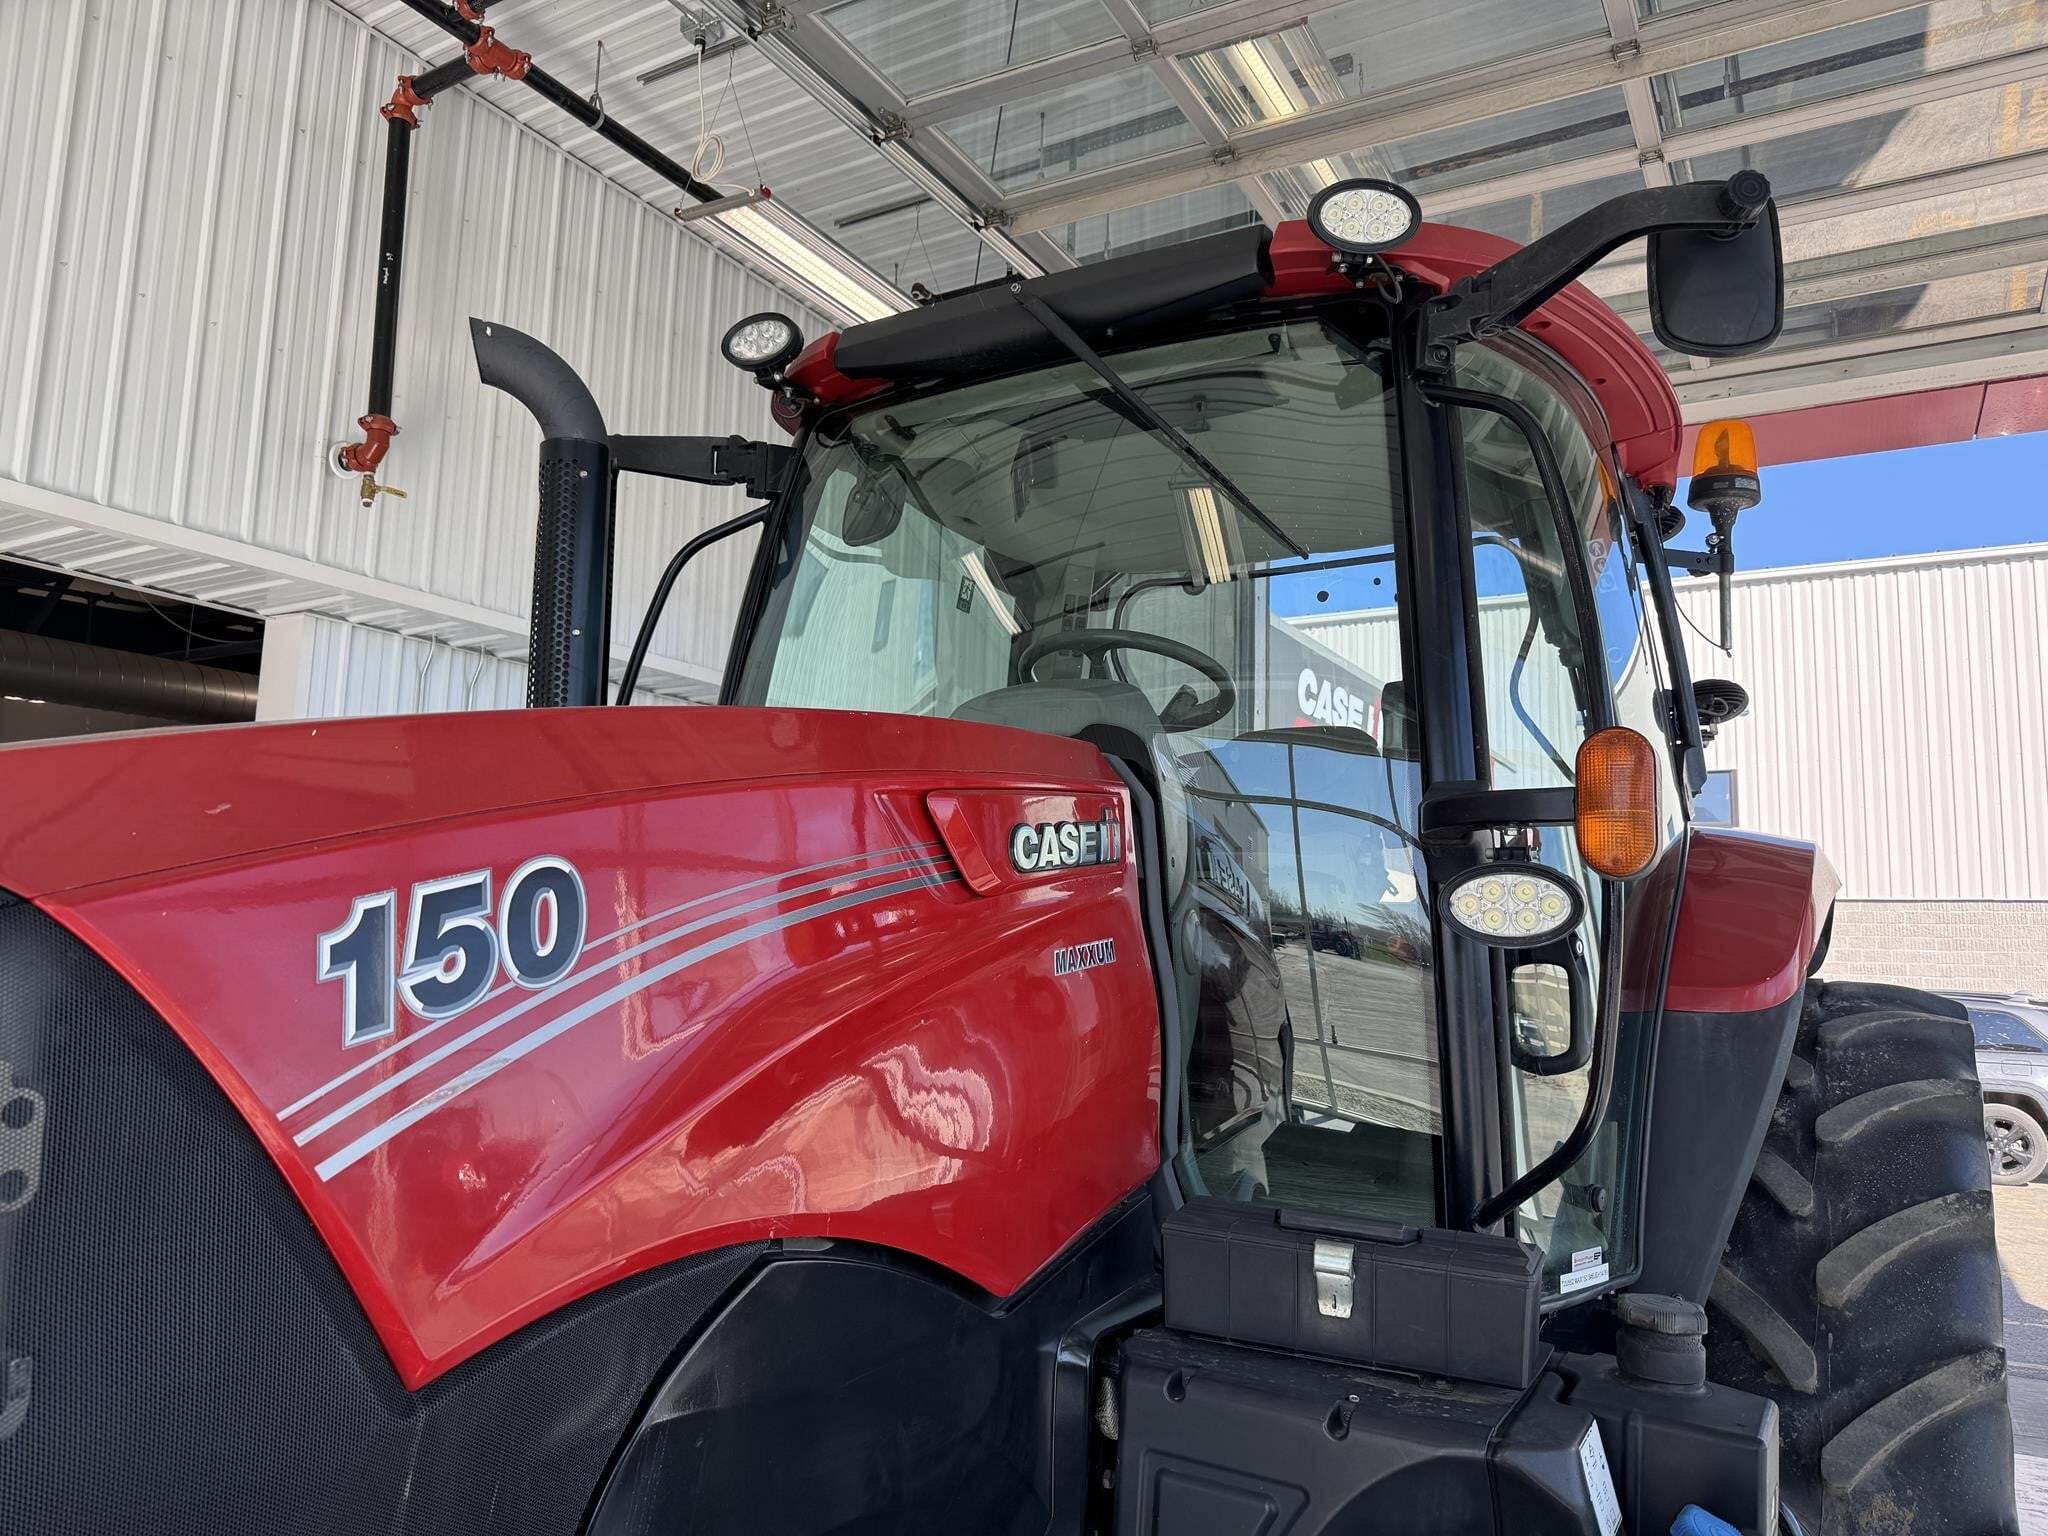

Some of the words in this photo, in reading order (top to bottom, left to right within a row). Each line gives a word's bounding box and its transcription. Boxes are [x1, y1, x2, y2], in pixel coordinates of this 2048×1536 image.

[1298, 668, 1364, 729] CASE
[1013, 821, 1097, 870] CASE
[317, 854, 588, 1050] 150
[1054, 938, 1117, 976] MAXXUM
